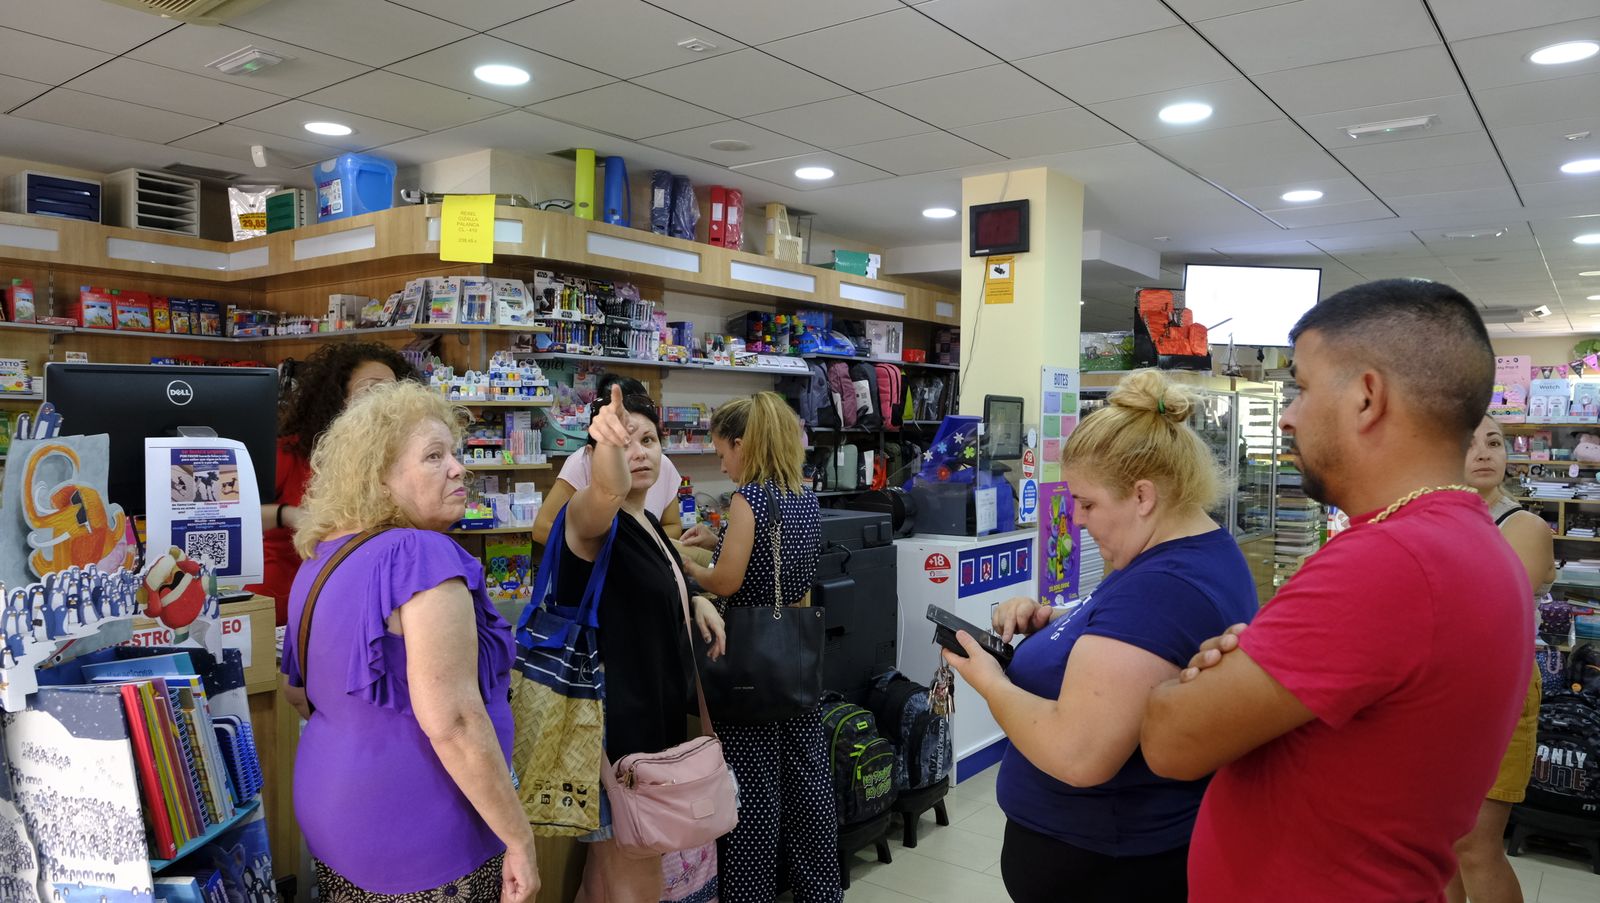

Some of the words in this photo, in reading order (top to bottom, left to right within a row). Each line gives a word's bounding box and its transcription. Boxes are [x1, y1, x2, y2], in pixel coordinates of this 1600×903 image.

[170, 388, 191, 396] DELL
[928, 555, 945, 566] +18
[1537, 745, 1587, 769] ONLY
